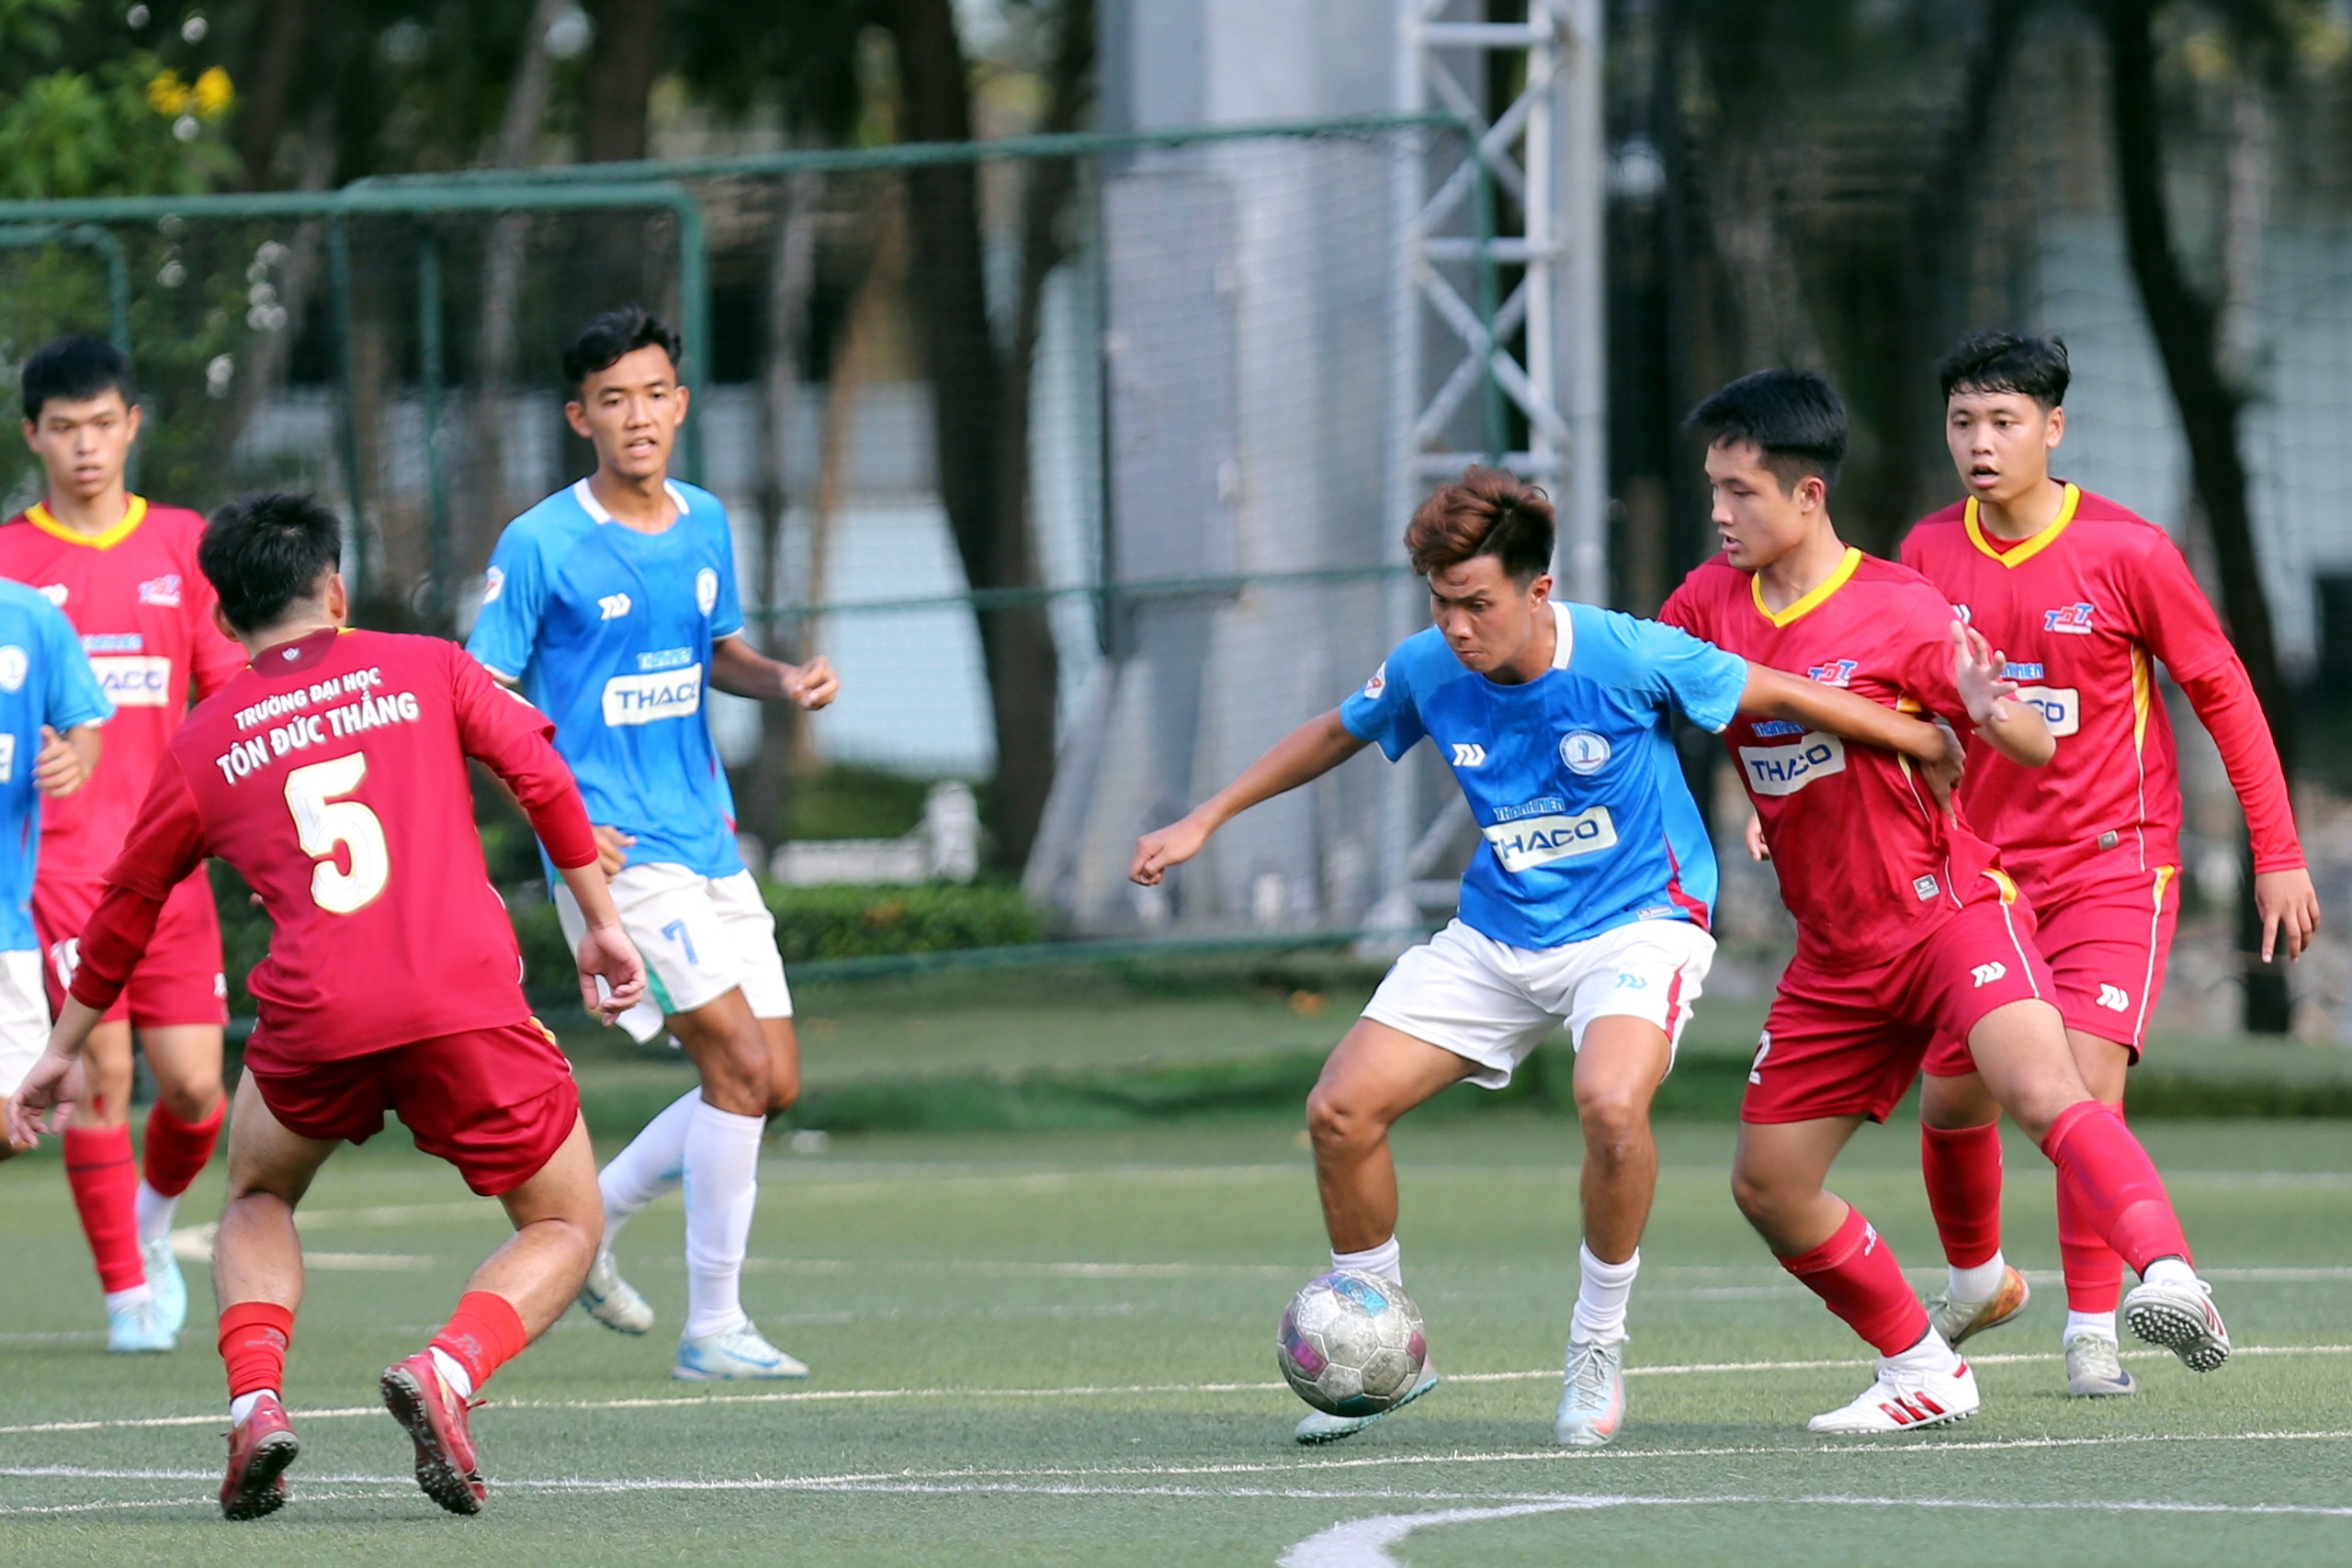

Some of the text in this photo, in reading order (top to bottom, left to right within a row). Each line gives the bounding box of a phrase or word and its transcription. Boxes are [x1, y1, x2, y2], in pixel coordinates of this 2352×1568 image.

[103, 671, 163, 692] ACO
[233, 667, 381, 730] TRƯỜNG ĐẠI HỌC
[216, 689, 419, 784] TÔN ĐỨC THẮNG
[283, 750, 390, 915] 5
[661, 919, 698, 965] 7
